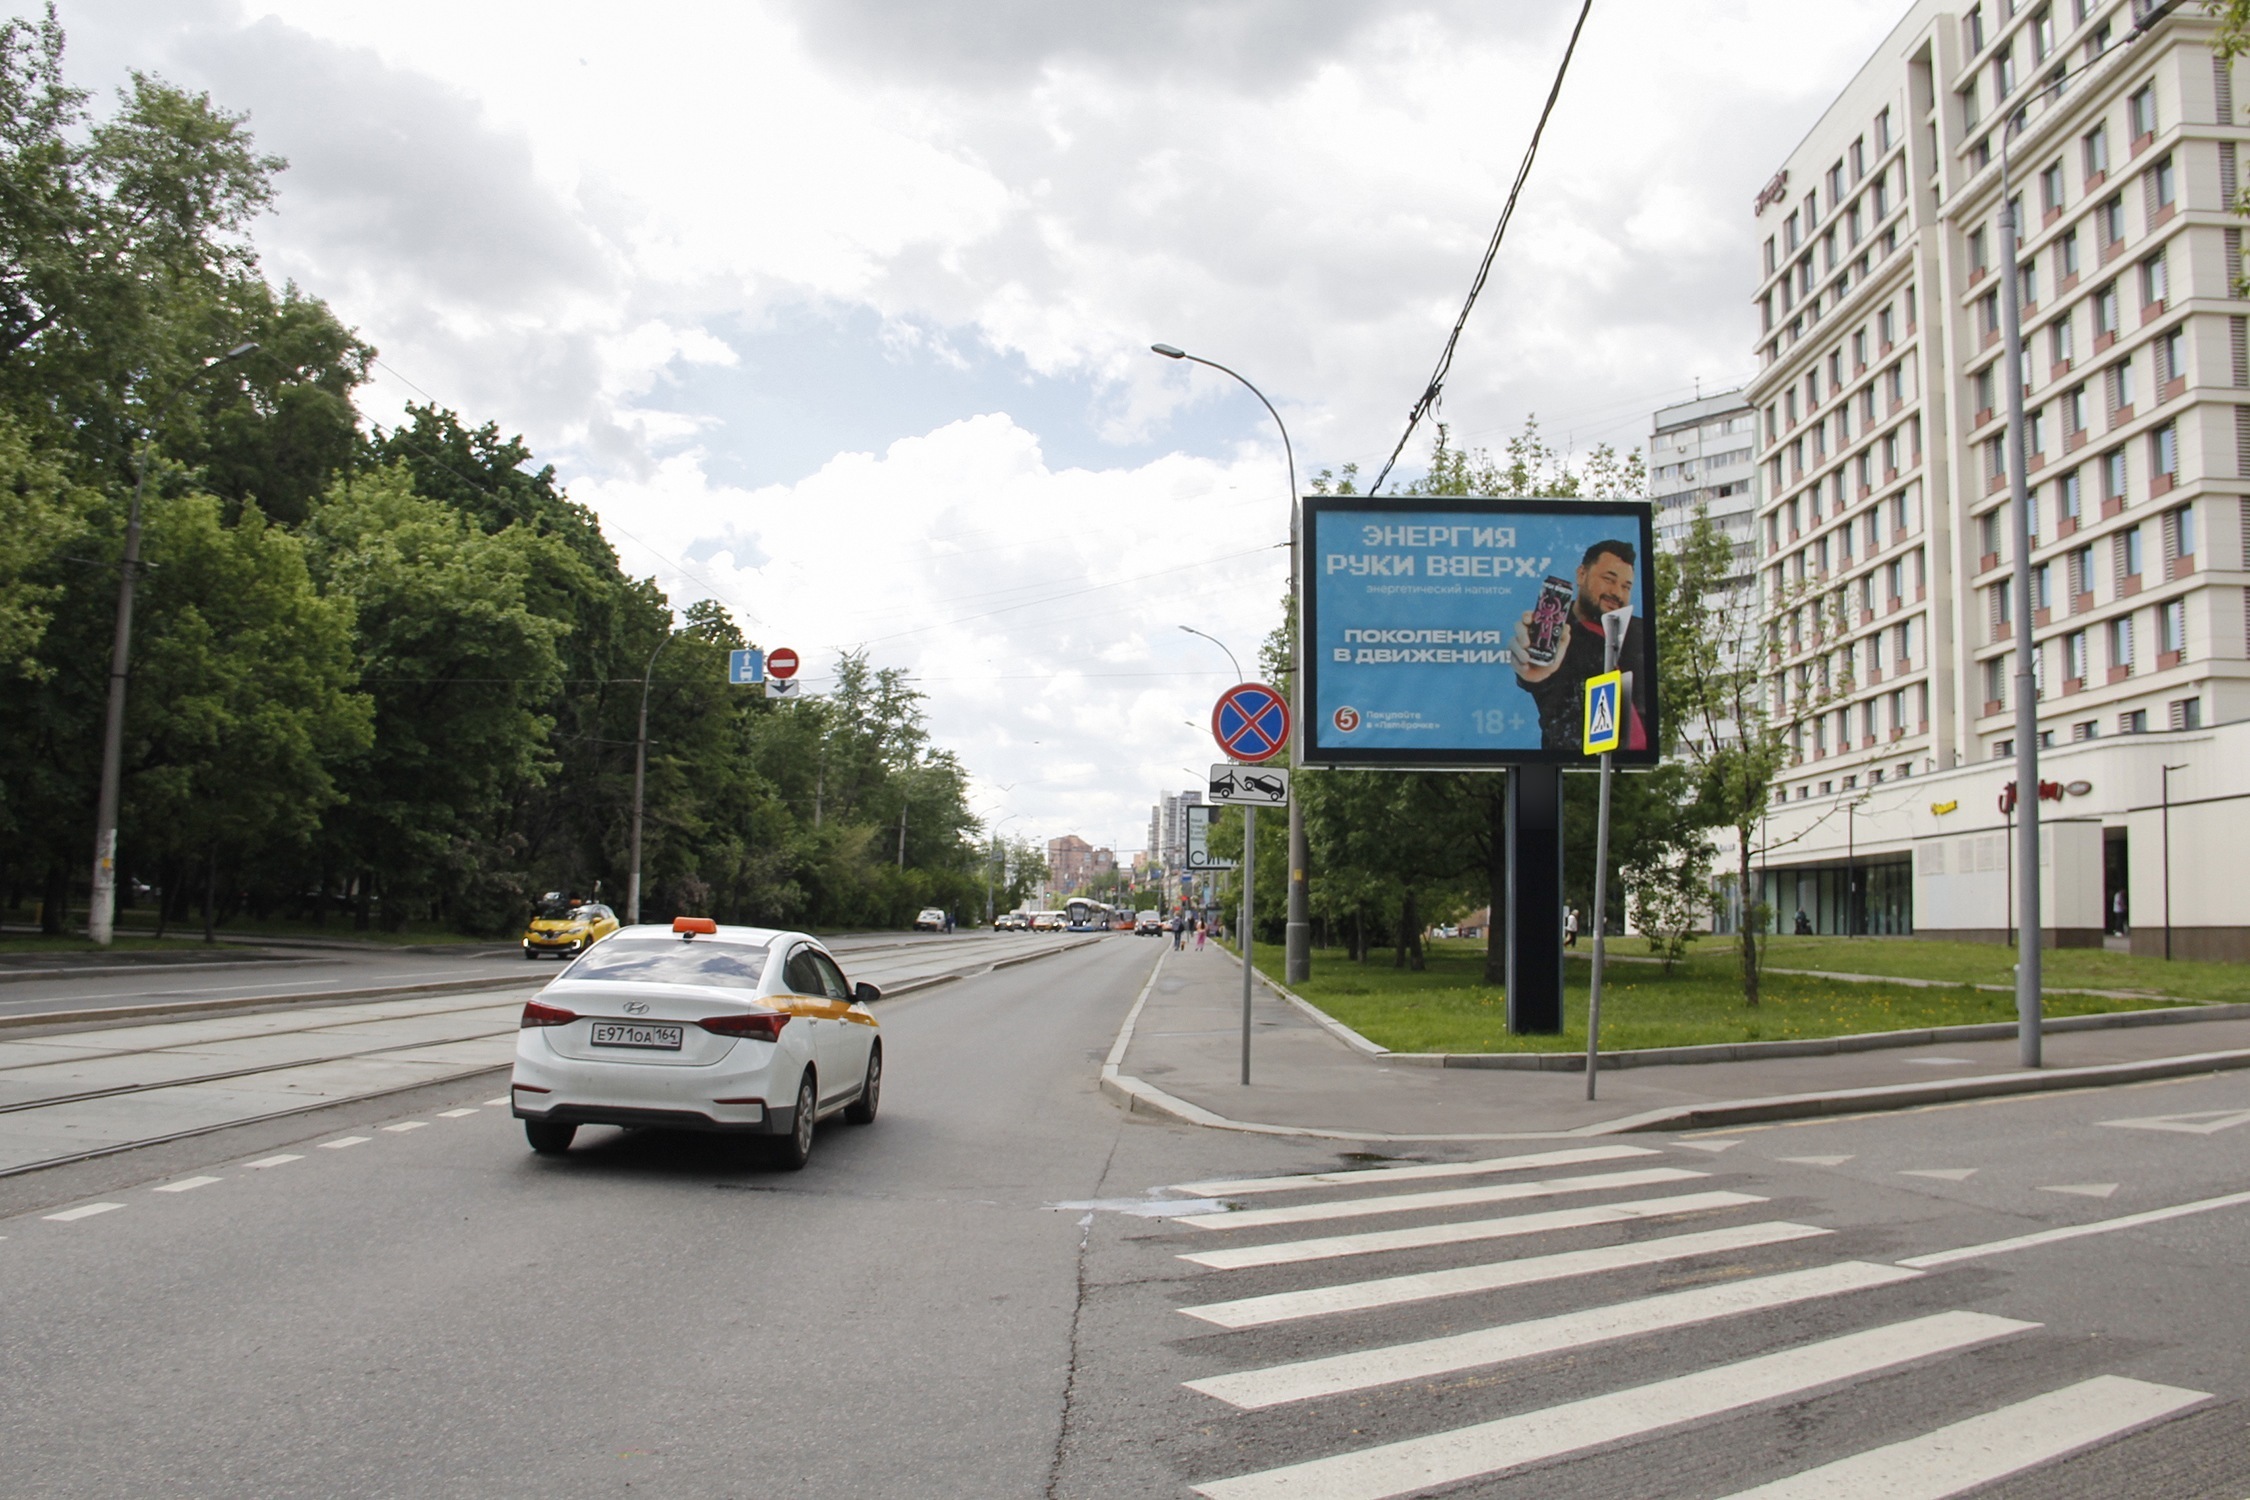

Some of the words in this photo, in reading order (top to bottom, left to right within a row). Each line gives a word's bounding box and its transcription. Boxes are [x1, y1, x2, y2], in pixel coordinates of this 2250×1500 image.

[1362, 525, 1516, 548] ЭНЕРГИЯ
[1326, 554, 1415, 576] РУКИ
[1366, 584, 1462, 595] энергетический
[1464, 585, 1512, 595] напиток
[1344, 629, 1500, 644] ПОКОЛЕНИЯ
[1333, 648, 1351, 662] В
[1355, 649, 1512, 664] ДВИЖЕНИИ!
[1471, 709, 1525, 734] 18+
[655, 1028, 677, 1041] 164
